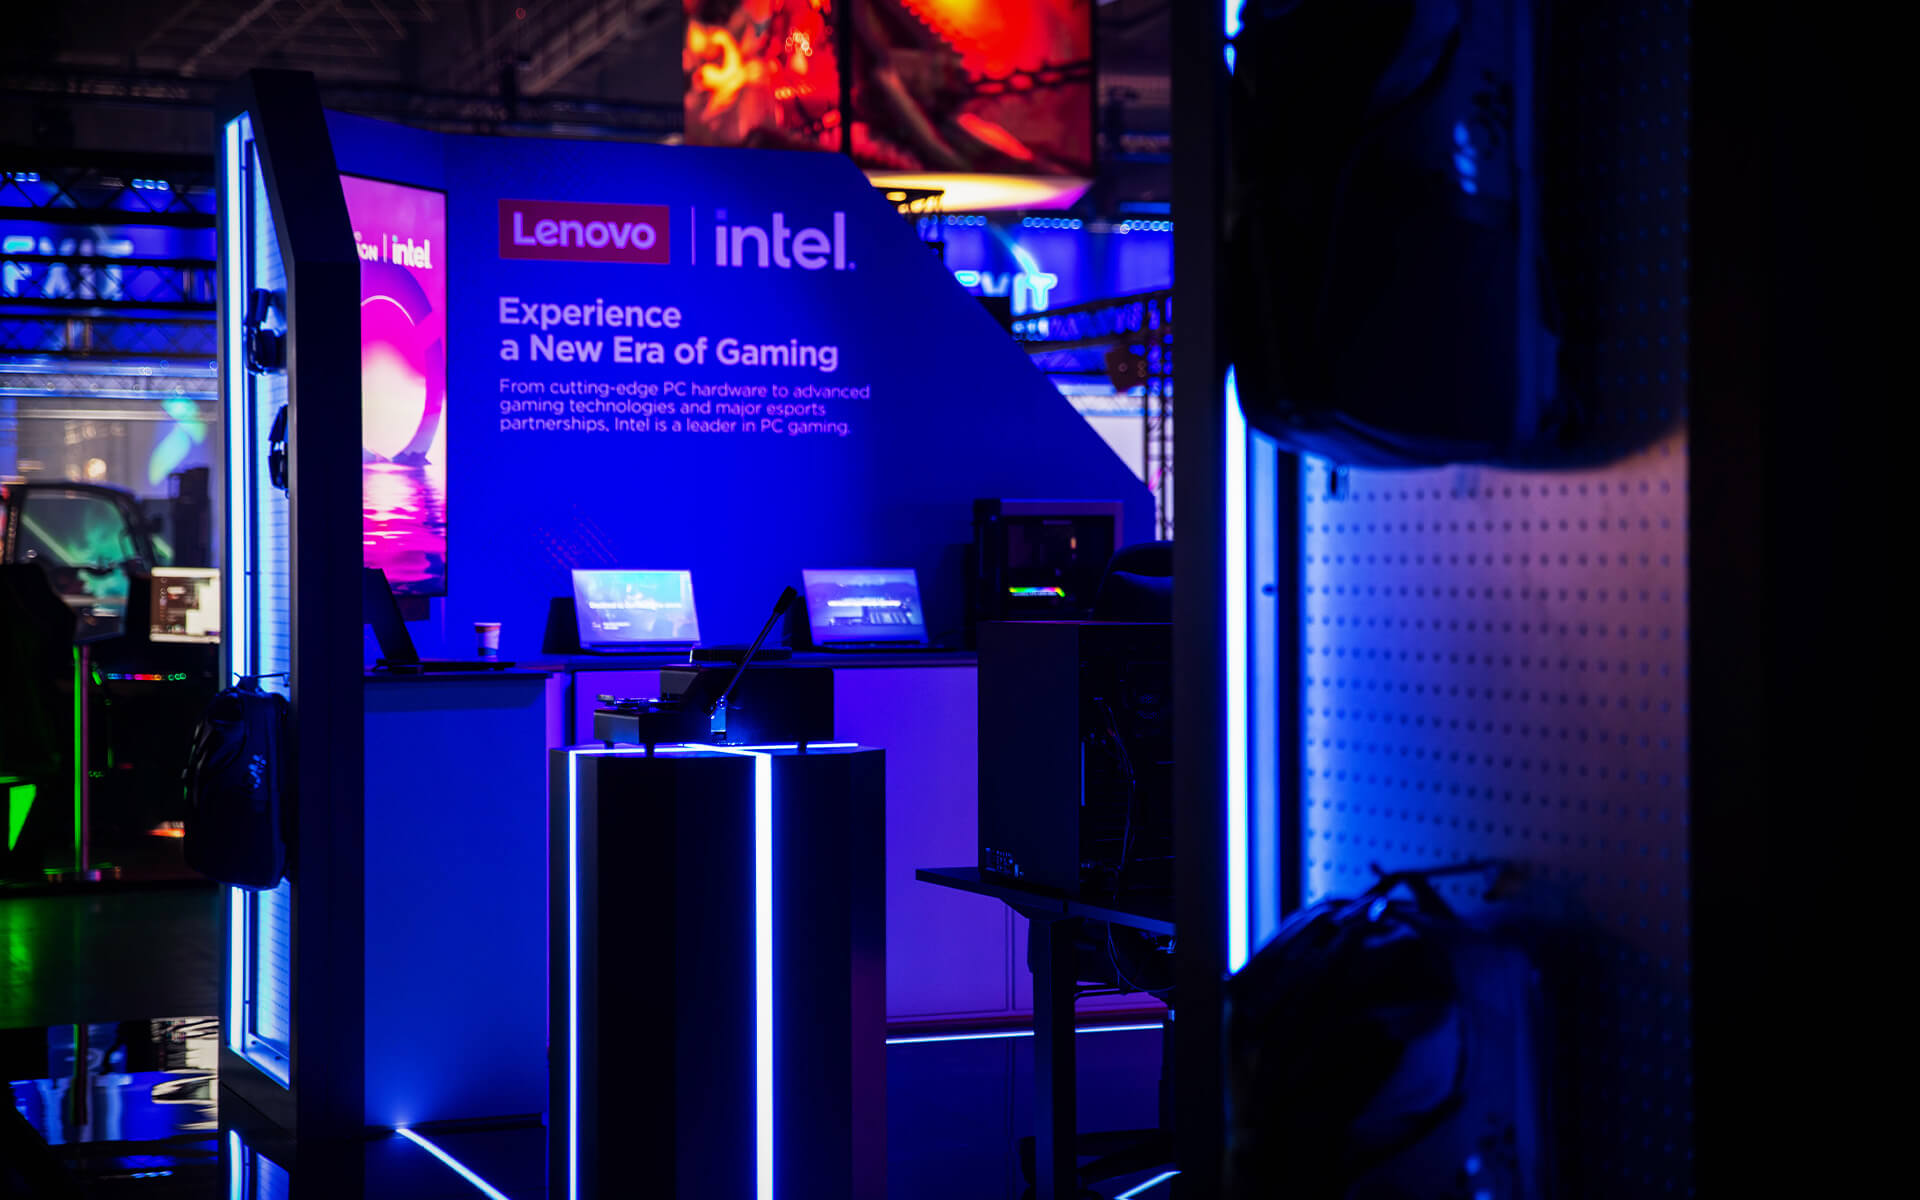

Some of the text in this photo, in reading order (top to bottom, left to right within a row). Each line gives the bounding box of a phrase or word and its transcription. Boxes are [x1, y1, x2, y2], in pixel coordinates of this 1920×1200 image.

[512, 211, 657, 251] Lenovo
[499, 296, 682, 330] Experience
[500, 334, 839, 373] a New Era of Gaming
[499, 378, 871, 400] From cutting-edge PC hardware to advanced
[499, 397, 826, 418] gaming technologies and major esports
[614, 416, 651, 432] Intel
[654, 418, 668, 432] is
[671, 421, 683, 432] a
[686, 417, 737, 433] leader
[741, 419, 757, 433] in
[760, 418, 784, 434] PC
[787, 420, 851, 437] gaming.
